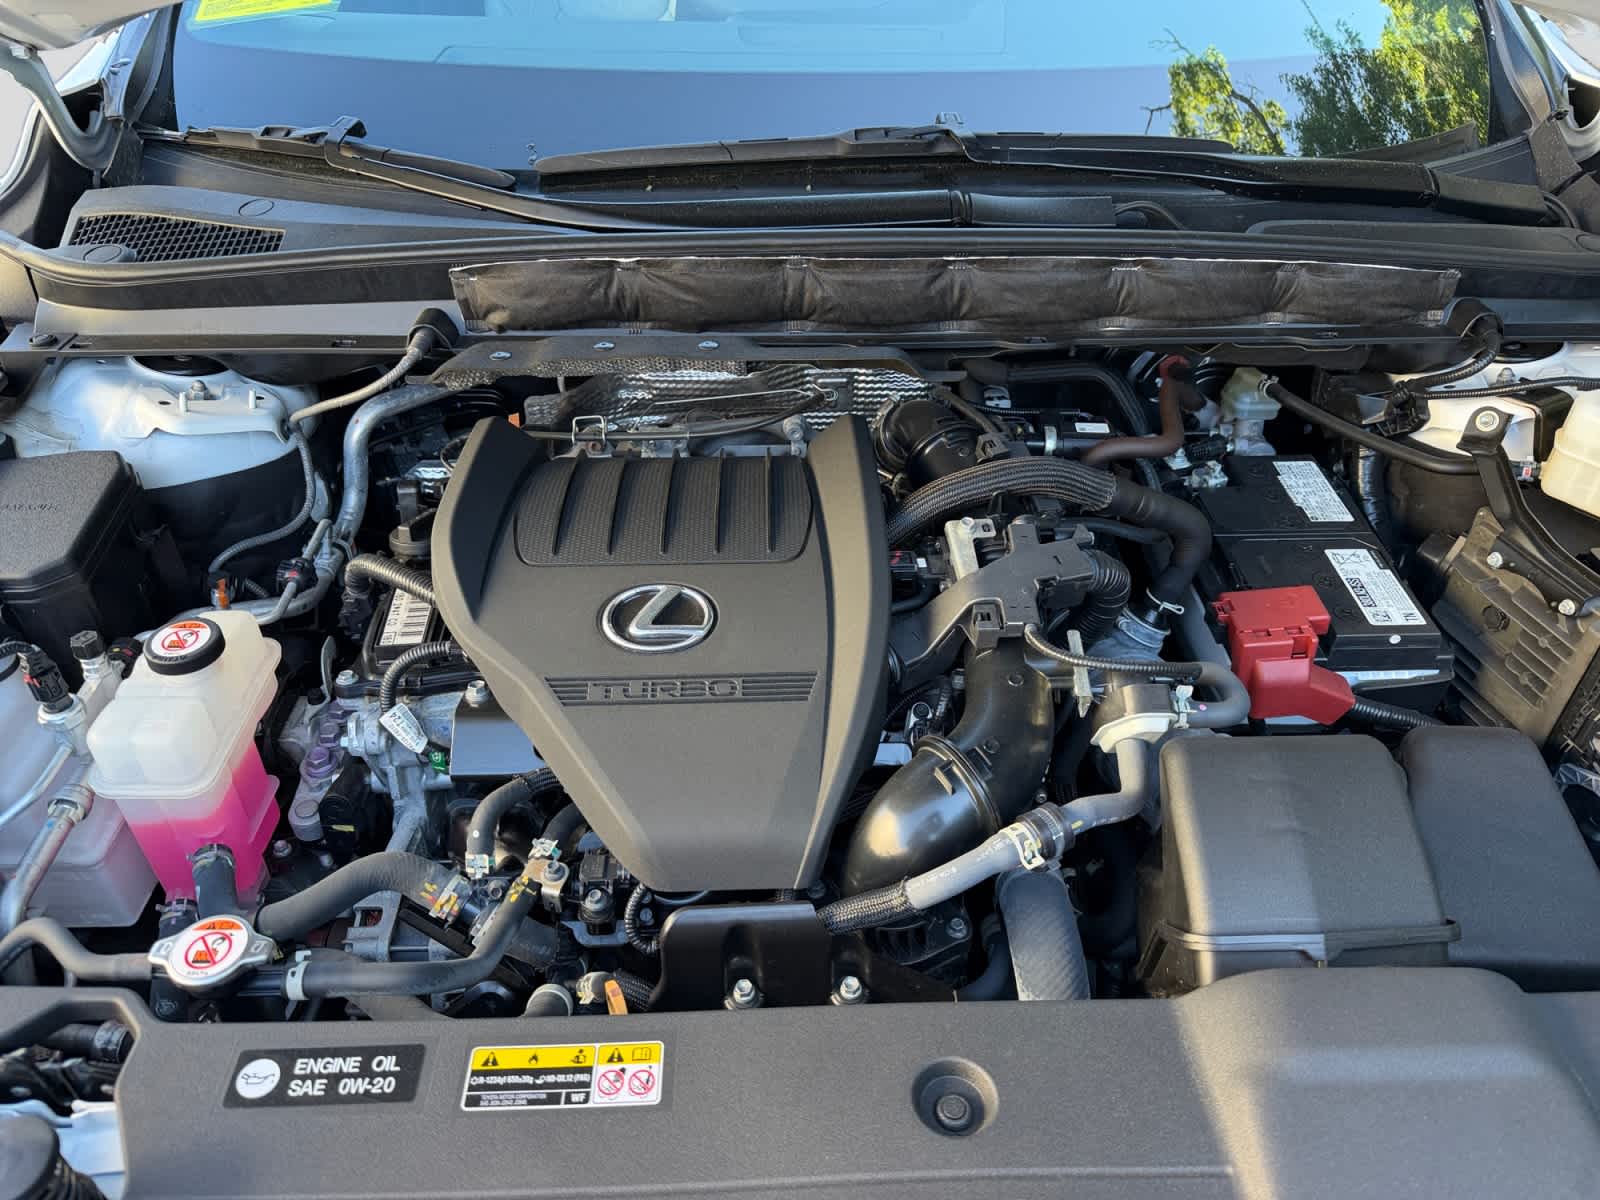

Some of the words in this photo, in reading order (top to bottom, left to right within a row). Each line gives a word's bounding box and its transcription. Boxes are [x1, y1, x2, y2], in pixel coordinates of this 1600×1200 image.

[591, 679, 739, 699] TURBO
[293, 1056, 362, 1075] ENGINE
[371, 1055, 401, 1072] OIL
[287, 1079, 328, 1097] SAE
[338, 1077, 396, 1095] 0W-20
